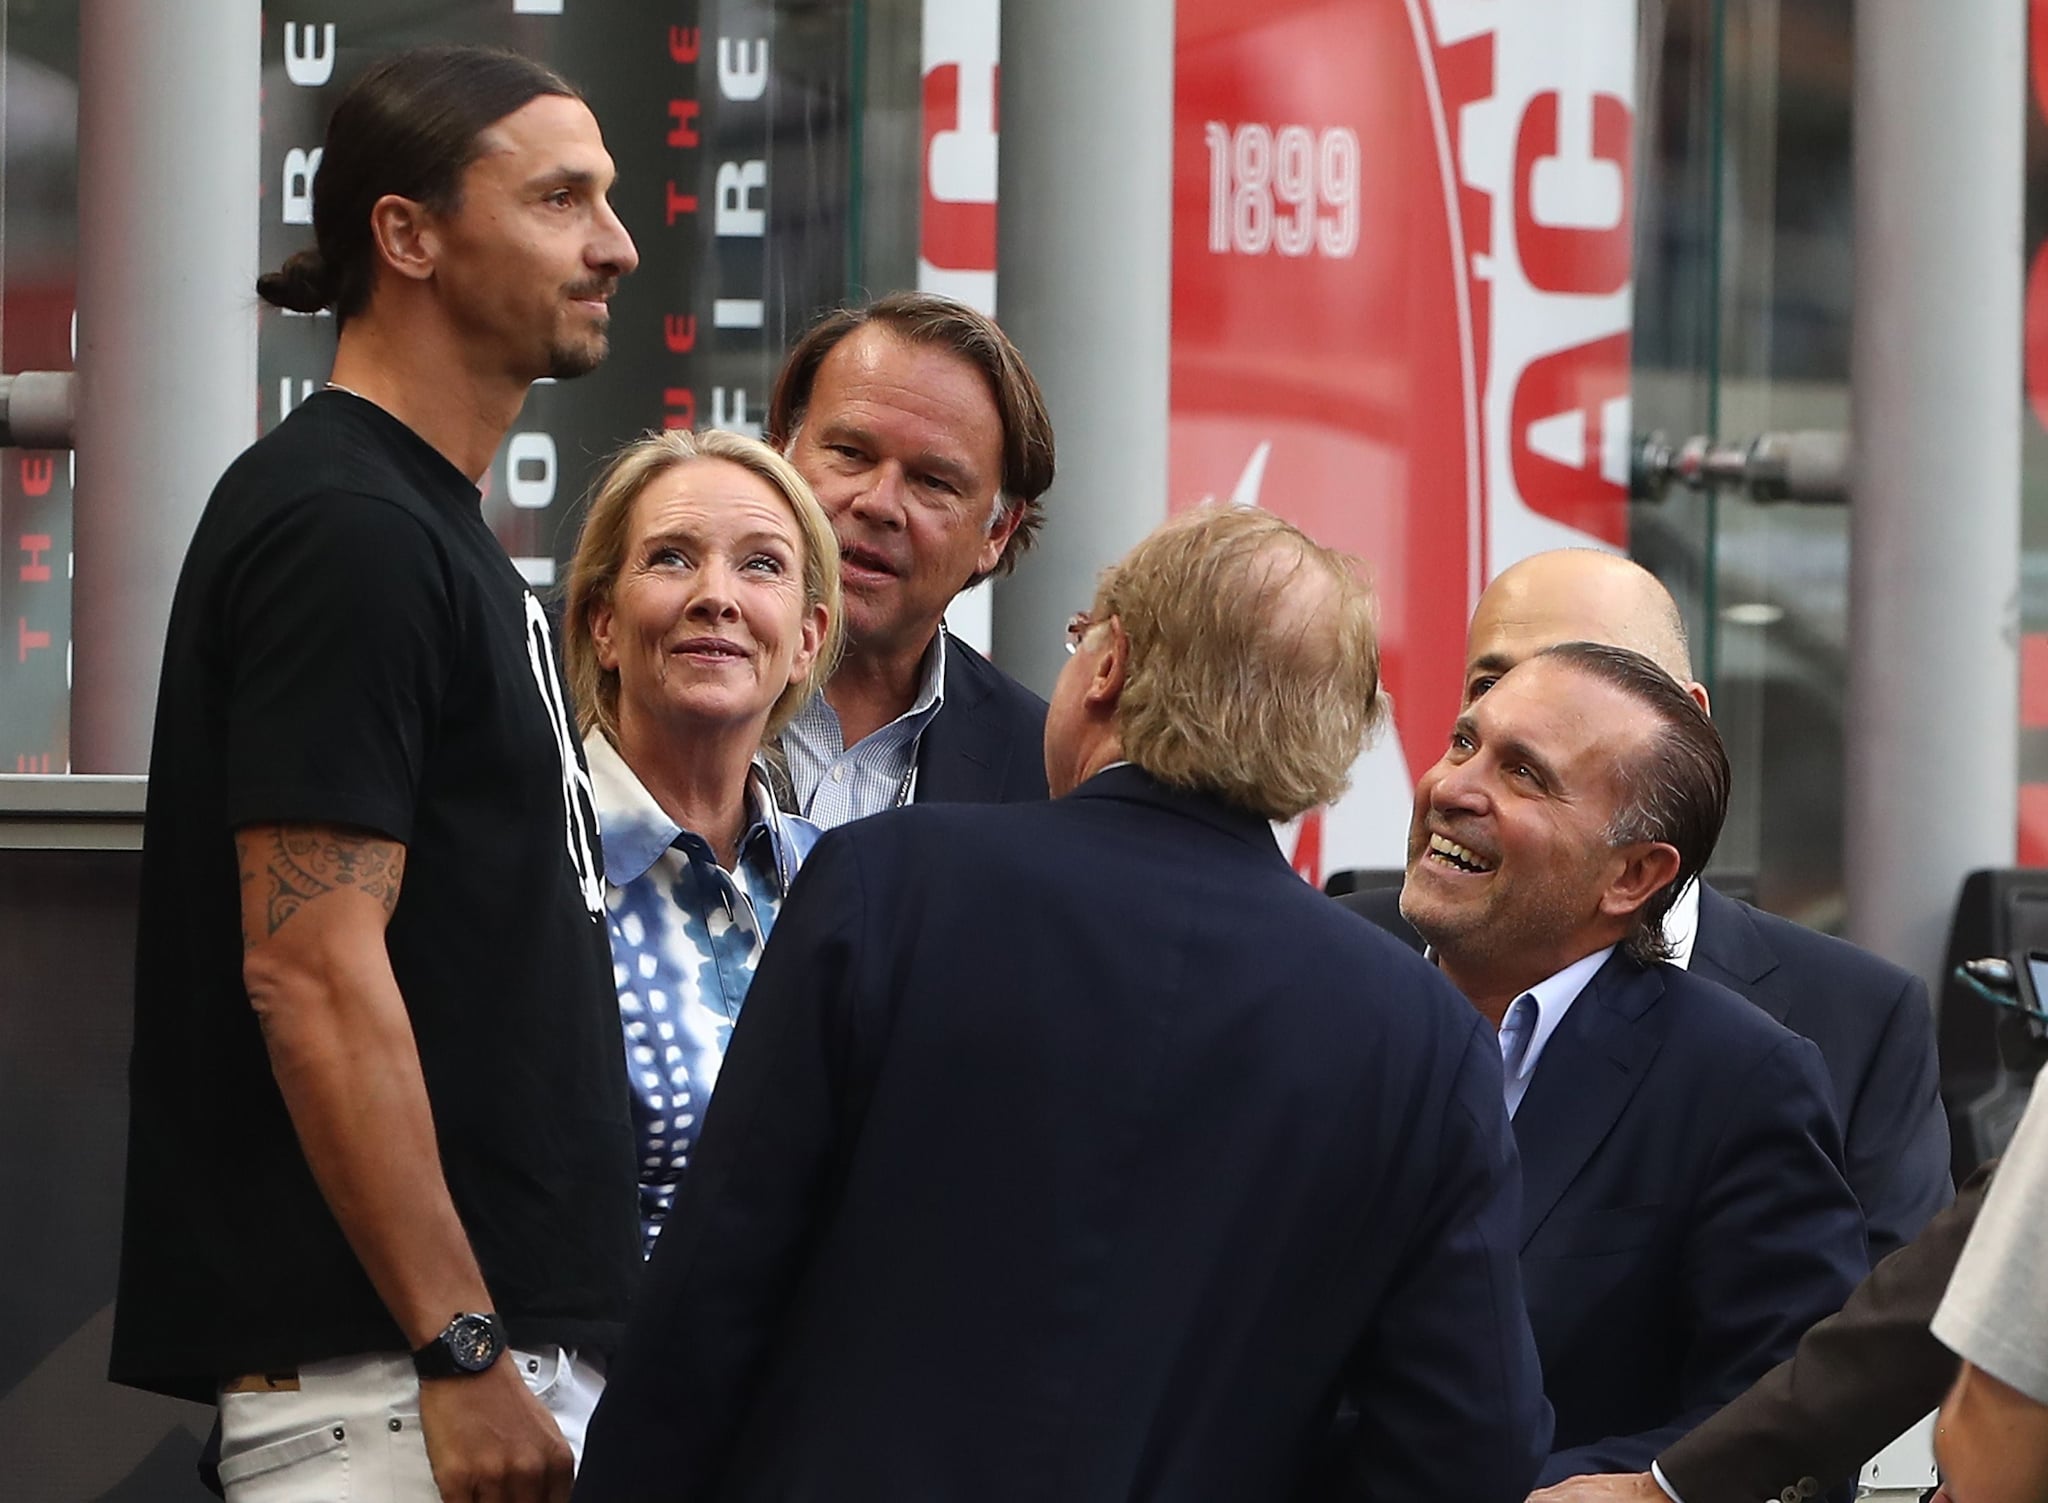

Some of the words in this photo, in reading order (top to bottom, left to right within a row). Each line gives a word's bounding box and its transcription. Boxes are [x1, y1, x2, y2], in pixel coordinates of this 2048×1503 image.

[666, 26, 699, 226] THE
[1205, 120, 1361, 258] 1899
[711, 37, 769, 441] FIRE
[18, 458, 54, 663] THE
